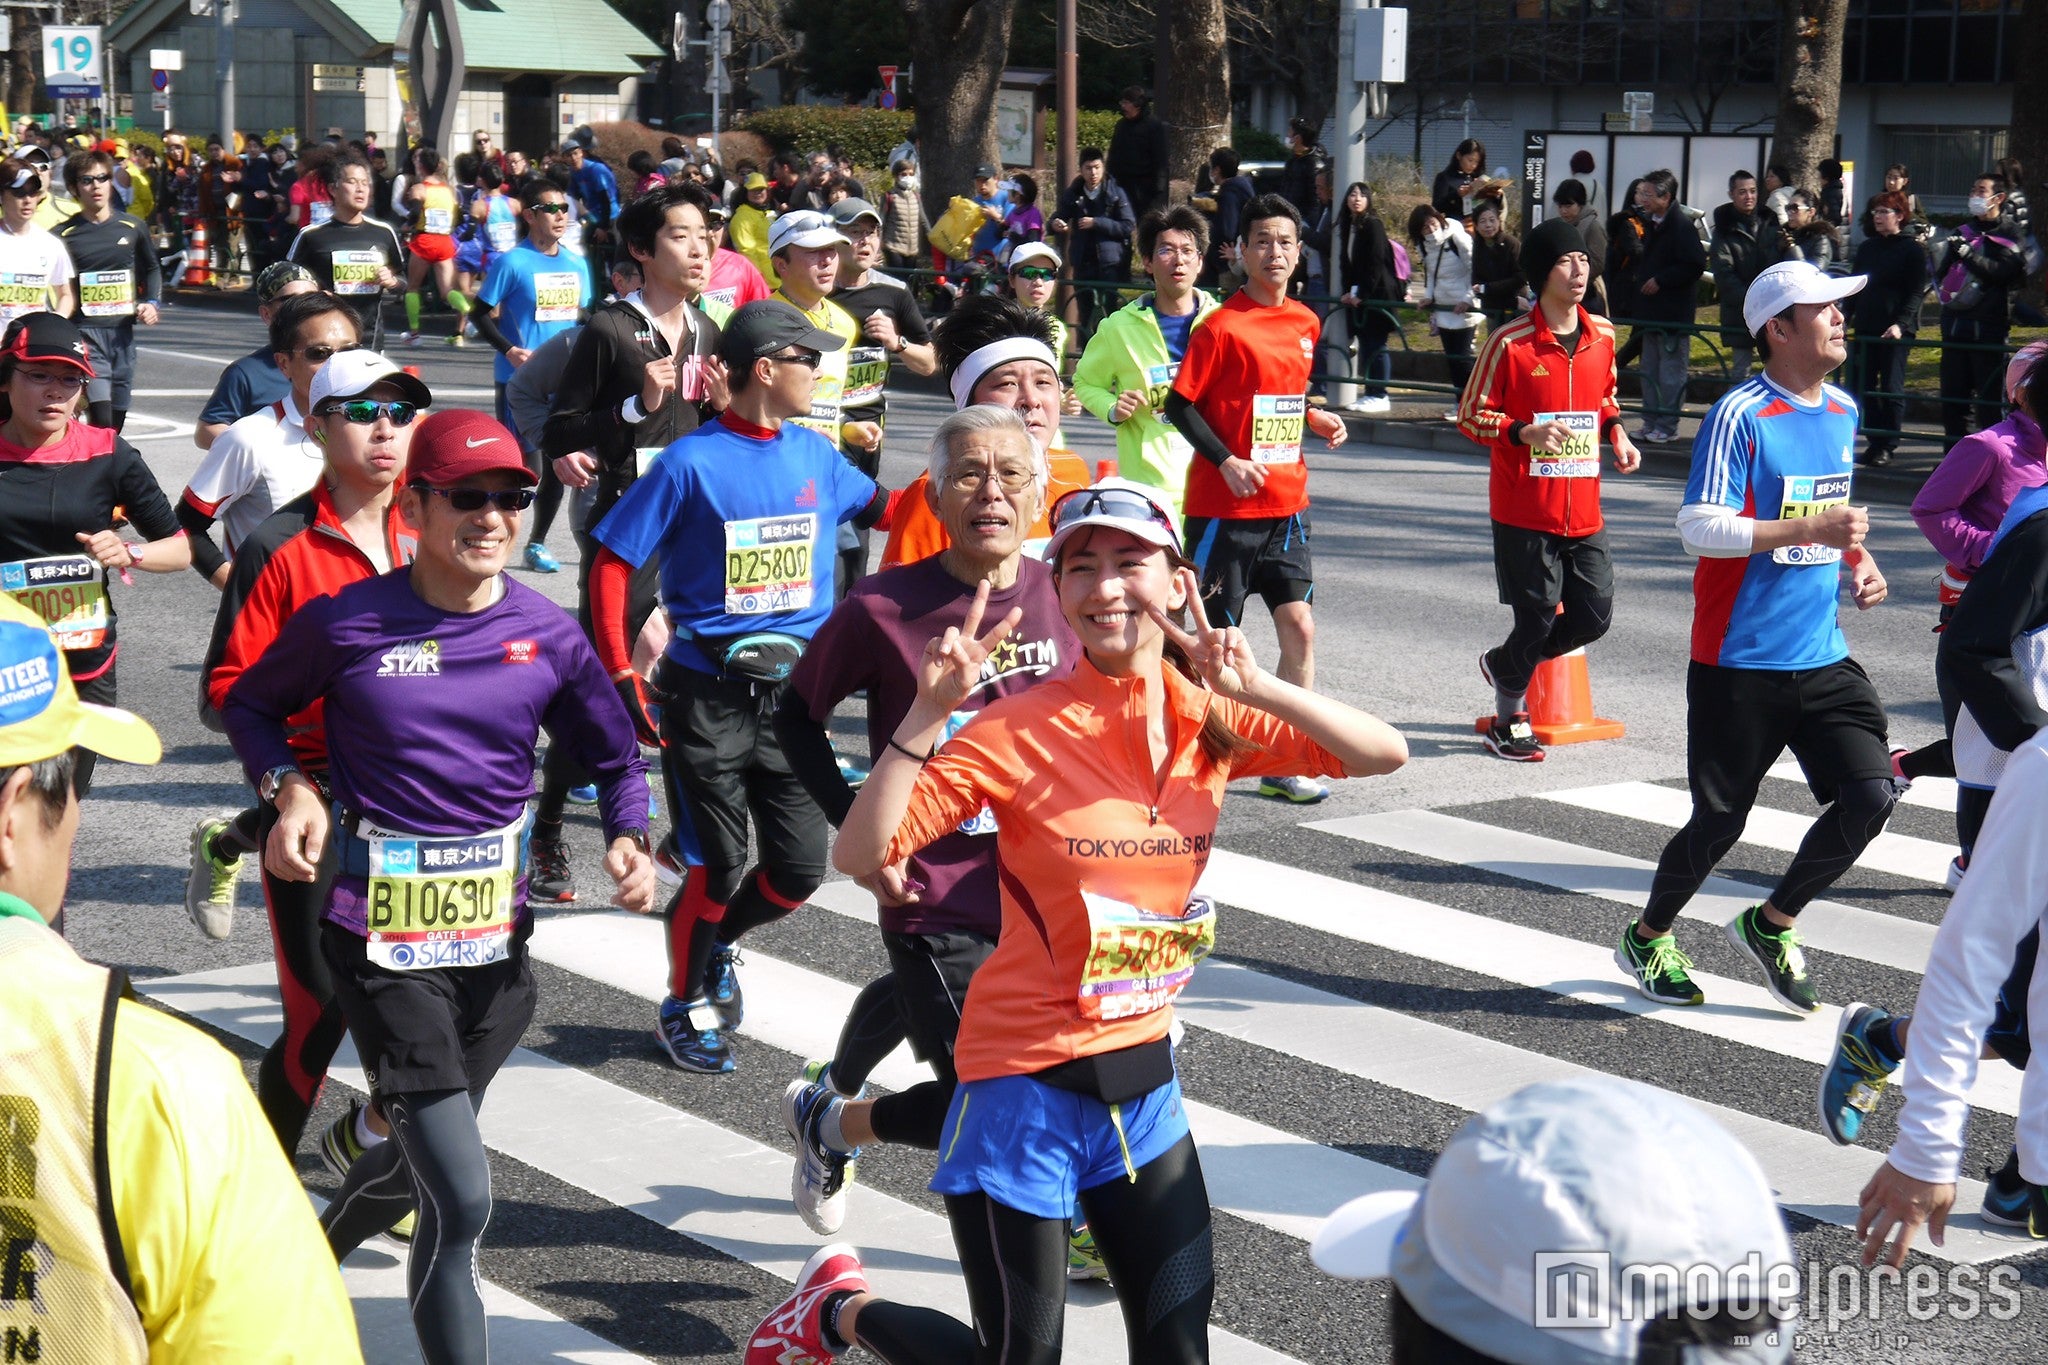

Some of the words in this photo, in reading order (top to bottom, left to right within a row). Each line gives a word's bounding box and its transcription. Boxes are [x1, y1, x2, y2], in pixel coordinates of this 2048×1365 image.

[51, 35, 92, 71] 19
[1525, 157, 1535, 181] Spot
[1533, 157, 1545, 199] Smoking
[334, 263, 376, 280] D25519
[82, 285, 124, 302] E26531
[1255, 416, 1300, 442] E27523
[1816, 481, 1849, 496] 東京メトロ
[761, 522, 810, 539] 東京メトロ
[29, 563, 90, 580] 東京メトロ
[729, 545, 807, 584] D25800
[511, 643, 530, 652] RUN
[377, 650, 440, 672] STAR
[423, 844, 500, 867] 東京メトロ
[1065, 837, 1138, 857] TOKYO
[1141, 836, 1191, 856] GIRLS
[372, 876, 495, 928] B10690
[382, 933, 407, 942] 2016
[427, 931, 457, 940] GATE
[1094, 984, 1114, 994] 2016
[1132, 978, 1159, 991] GATE
